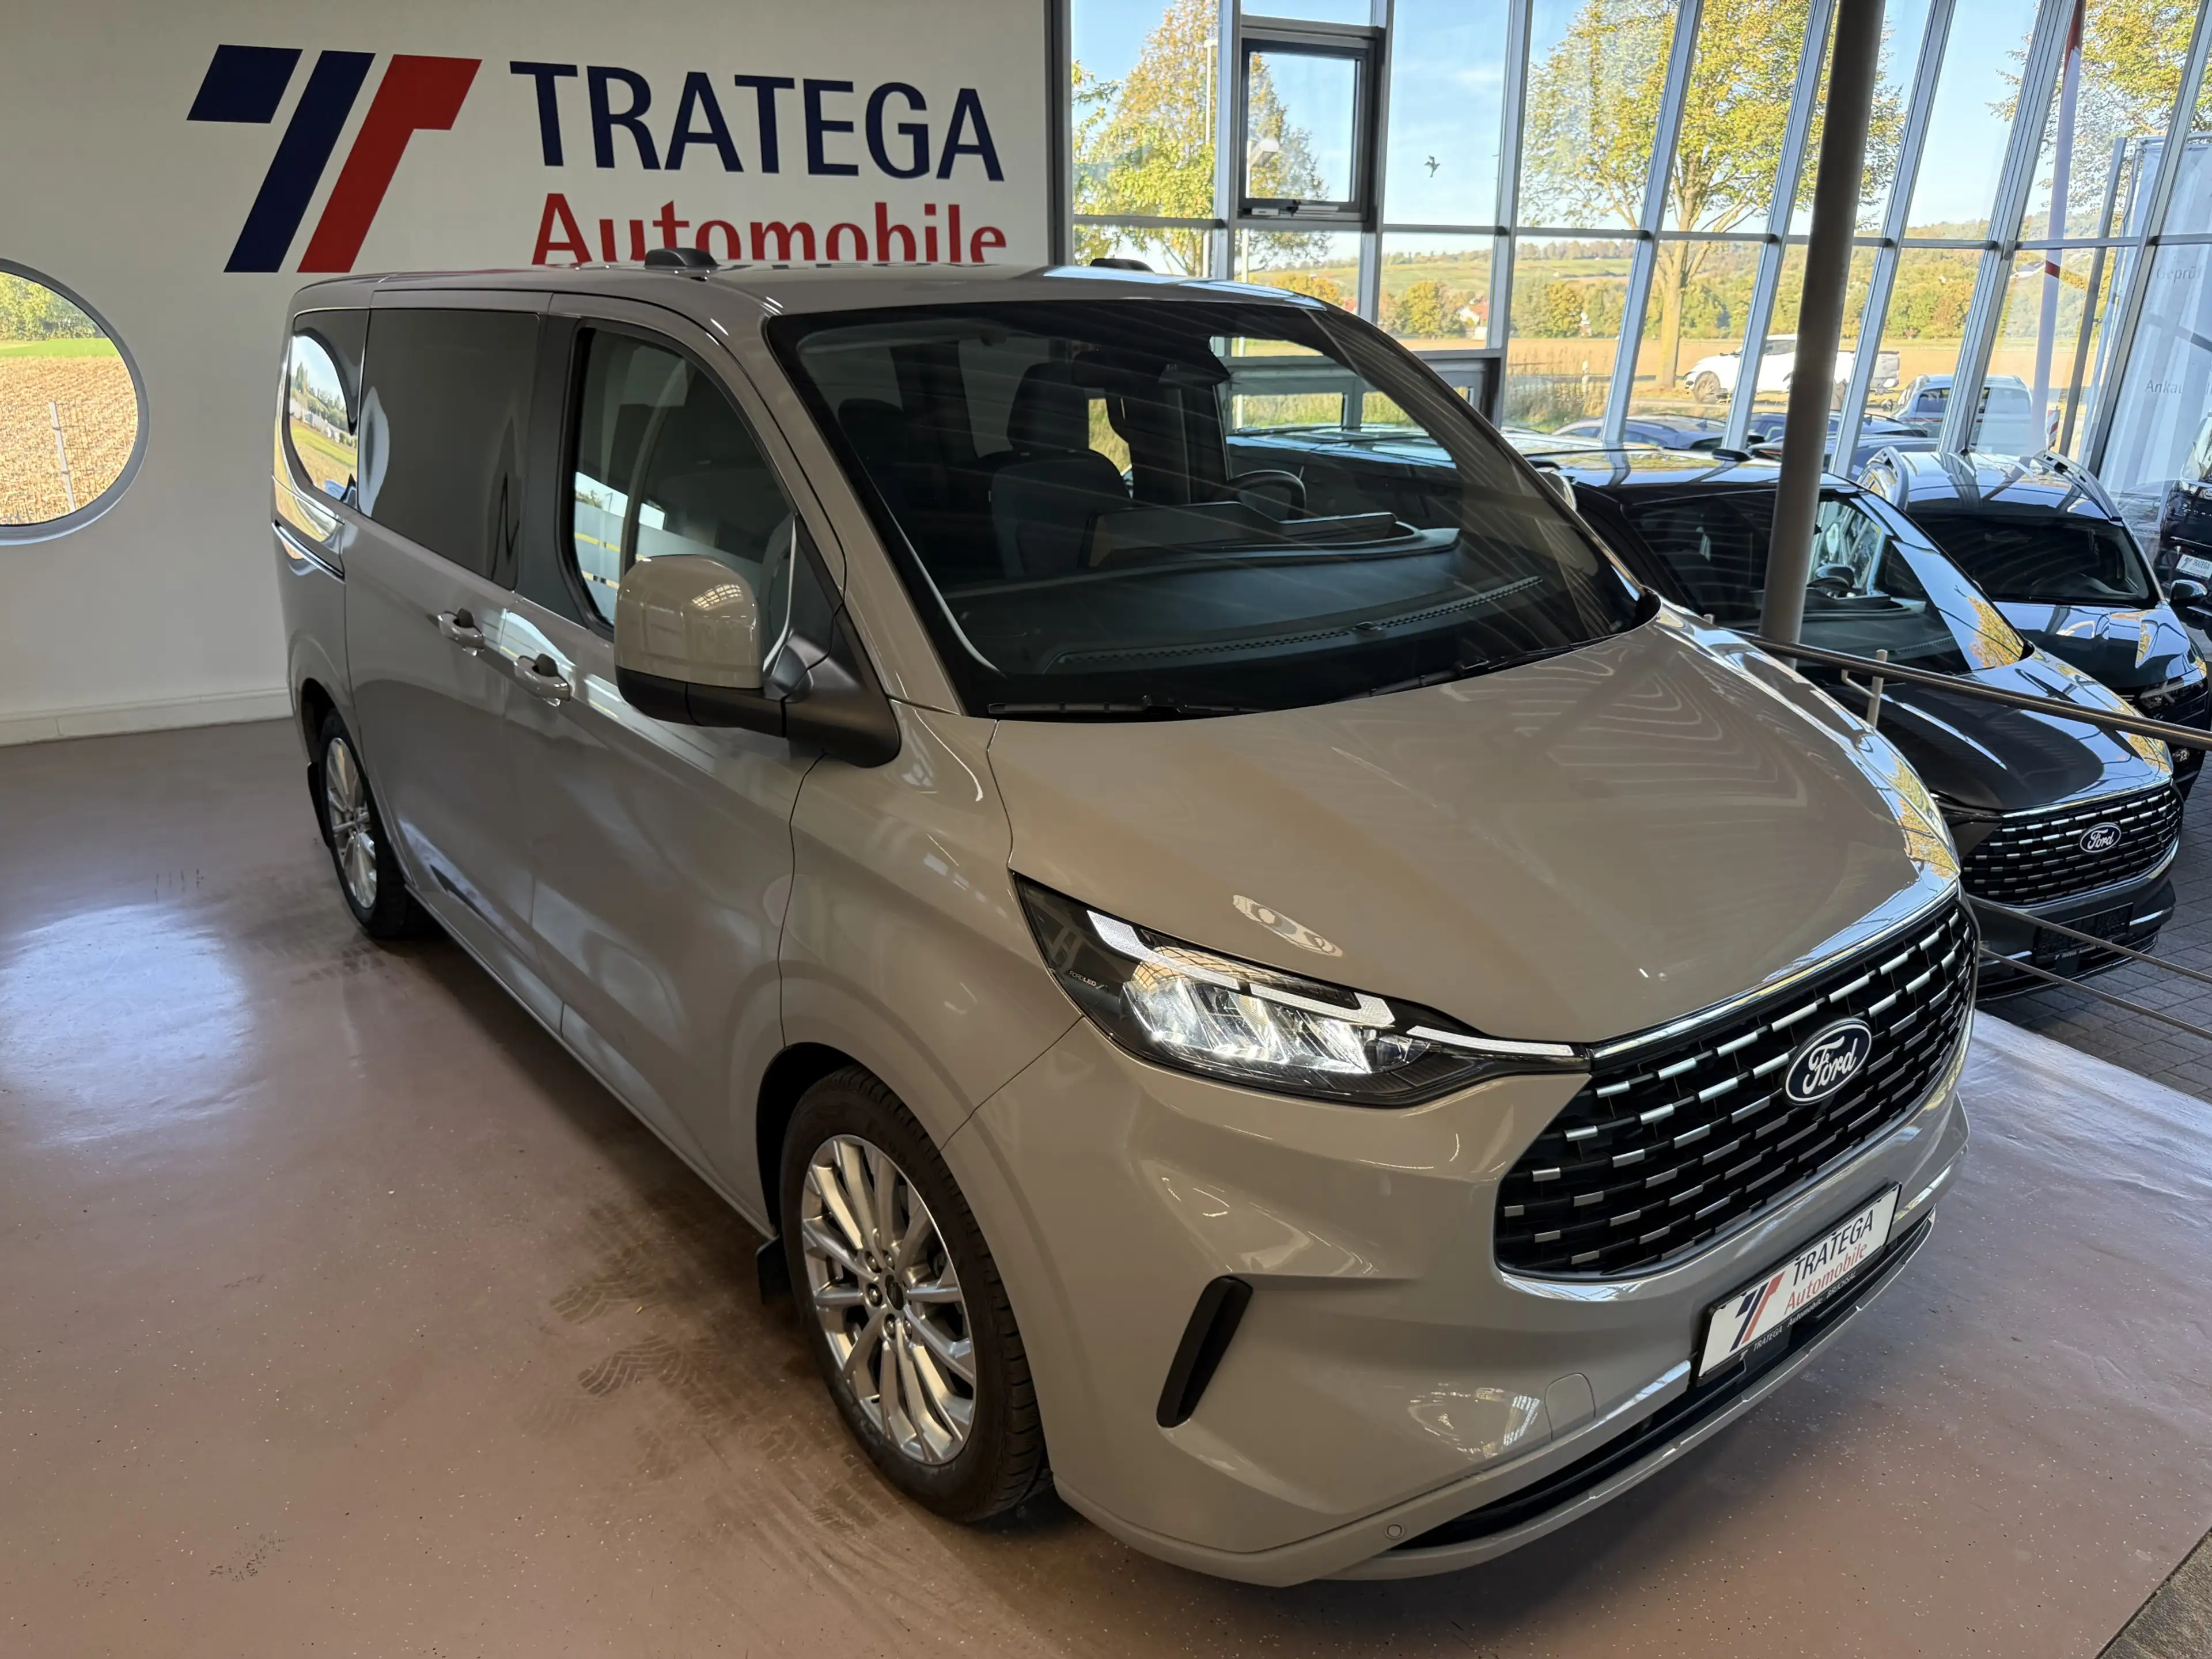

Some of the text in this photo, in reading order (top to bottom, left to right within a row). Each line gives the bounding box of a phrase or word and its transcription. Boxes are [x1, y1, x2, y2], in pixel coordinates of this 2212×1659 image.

[509, 60, 1005, 182] TRATEGA
[532, 193, 1007, 265] Automobile
[2086, 828, 2115, 850] Ford
[1802, 1036, 1857, 1095] Ford
[1784, 1243, 1867, 1316] Automobile
[1793, 1210, 1873, 1286] TRATEGA
[1753, 1325, 1783, 1351] TRATEGA
